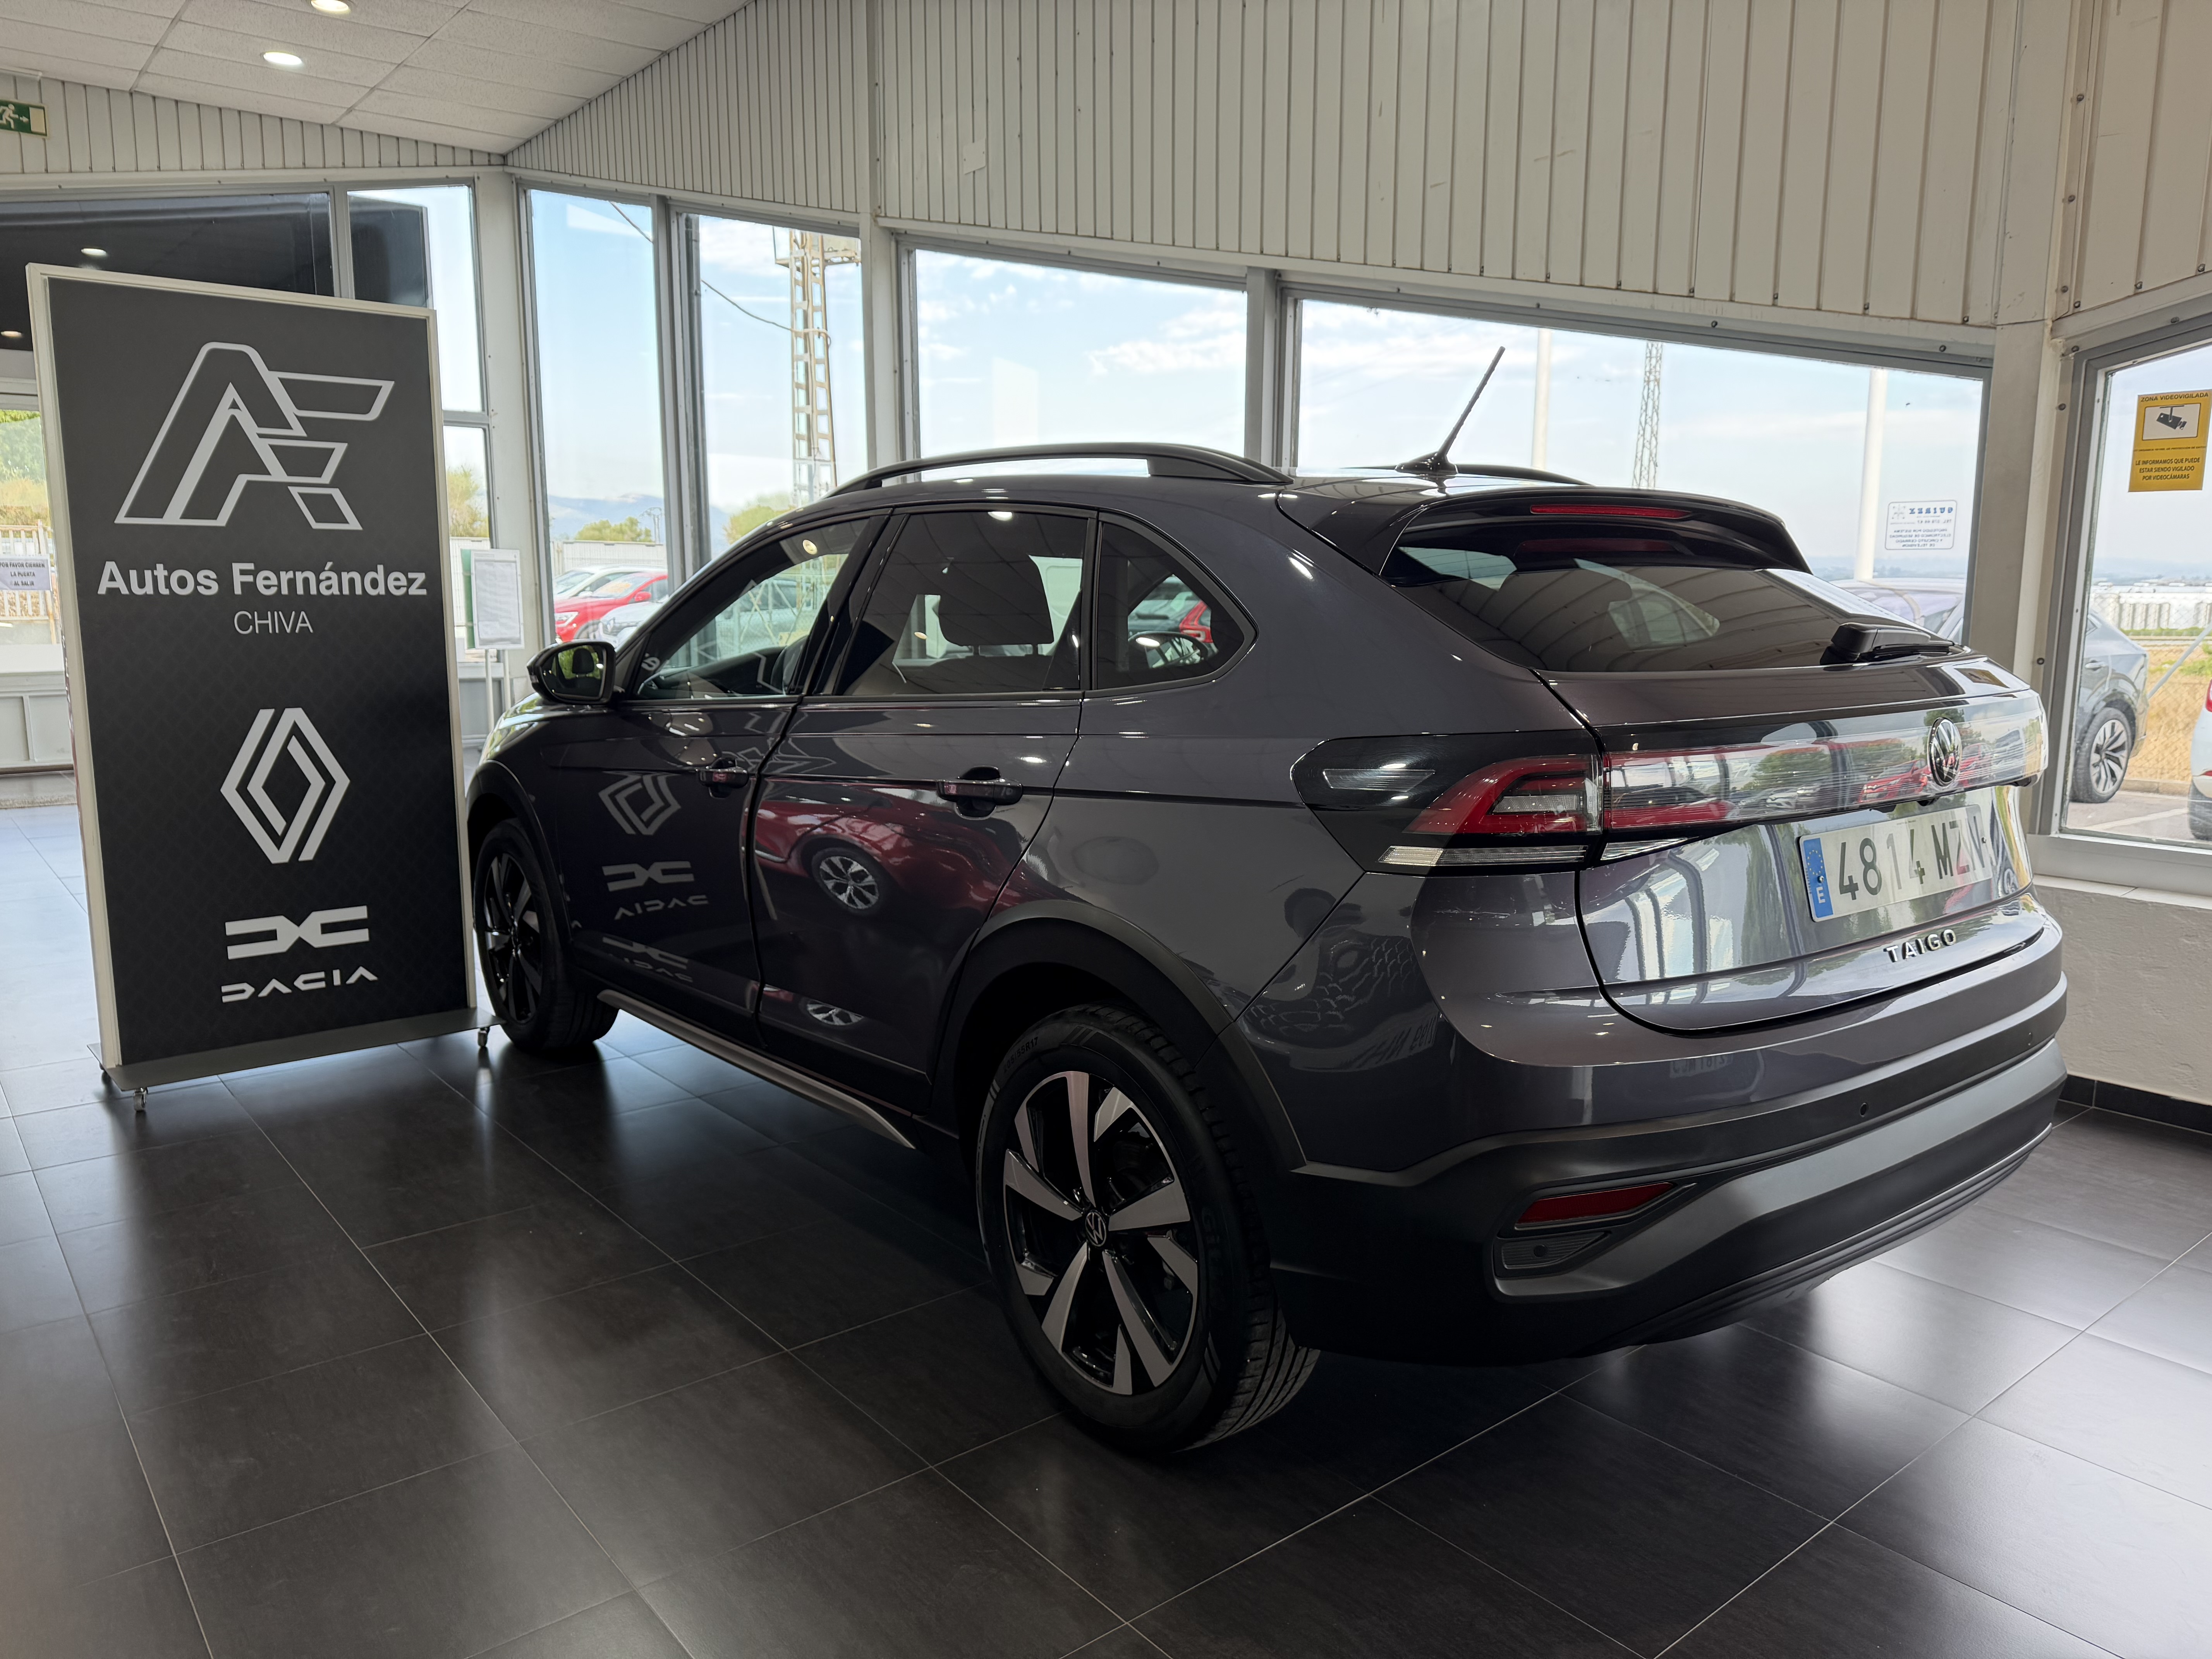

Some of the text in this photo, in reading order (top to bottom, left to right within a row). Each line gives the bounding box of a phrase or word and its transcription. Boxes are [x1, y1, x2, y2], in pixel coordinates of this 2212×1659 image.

[97, 561, 427, 596] Autos Fernández
[234, 611, 313, 634] CHIVA
[1838, 829, 1926, 900] 4814
[1931, 816, 1985, 879] MZN
[1816, 886, 1826, 904] E
[1884, 929, 1956, 962] TAIGO
[221, 966, 378, 1003] DACIA
